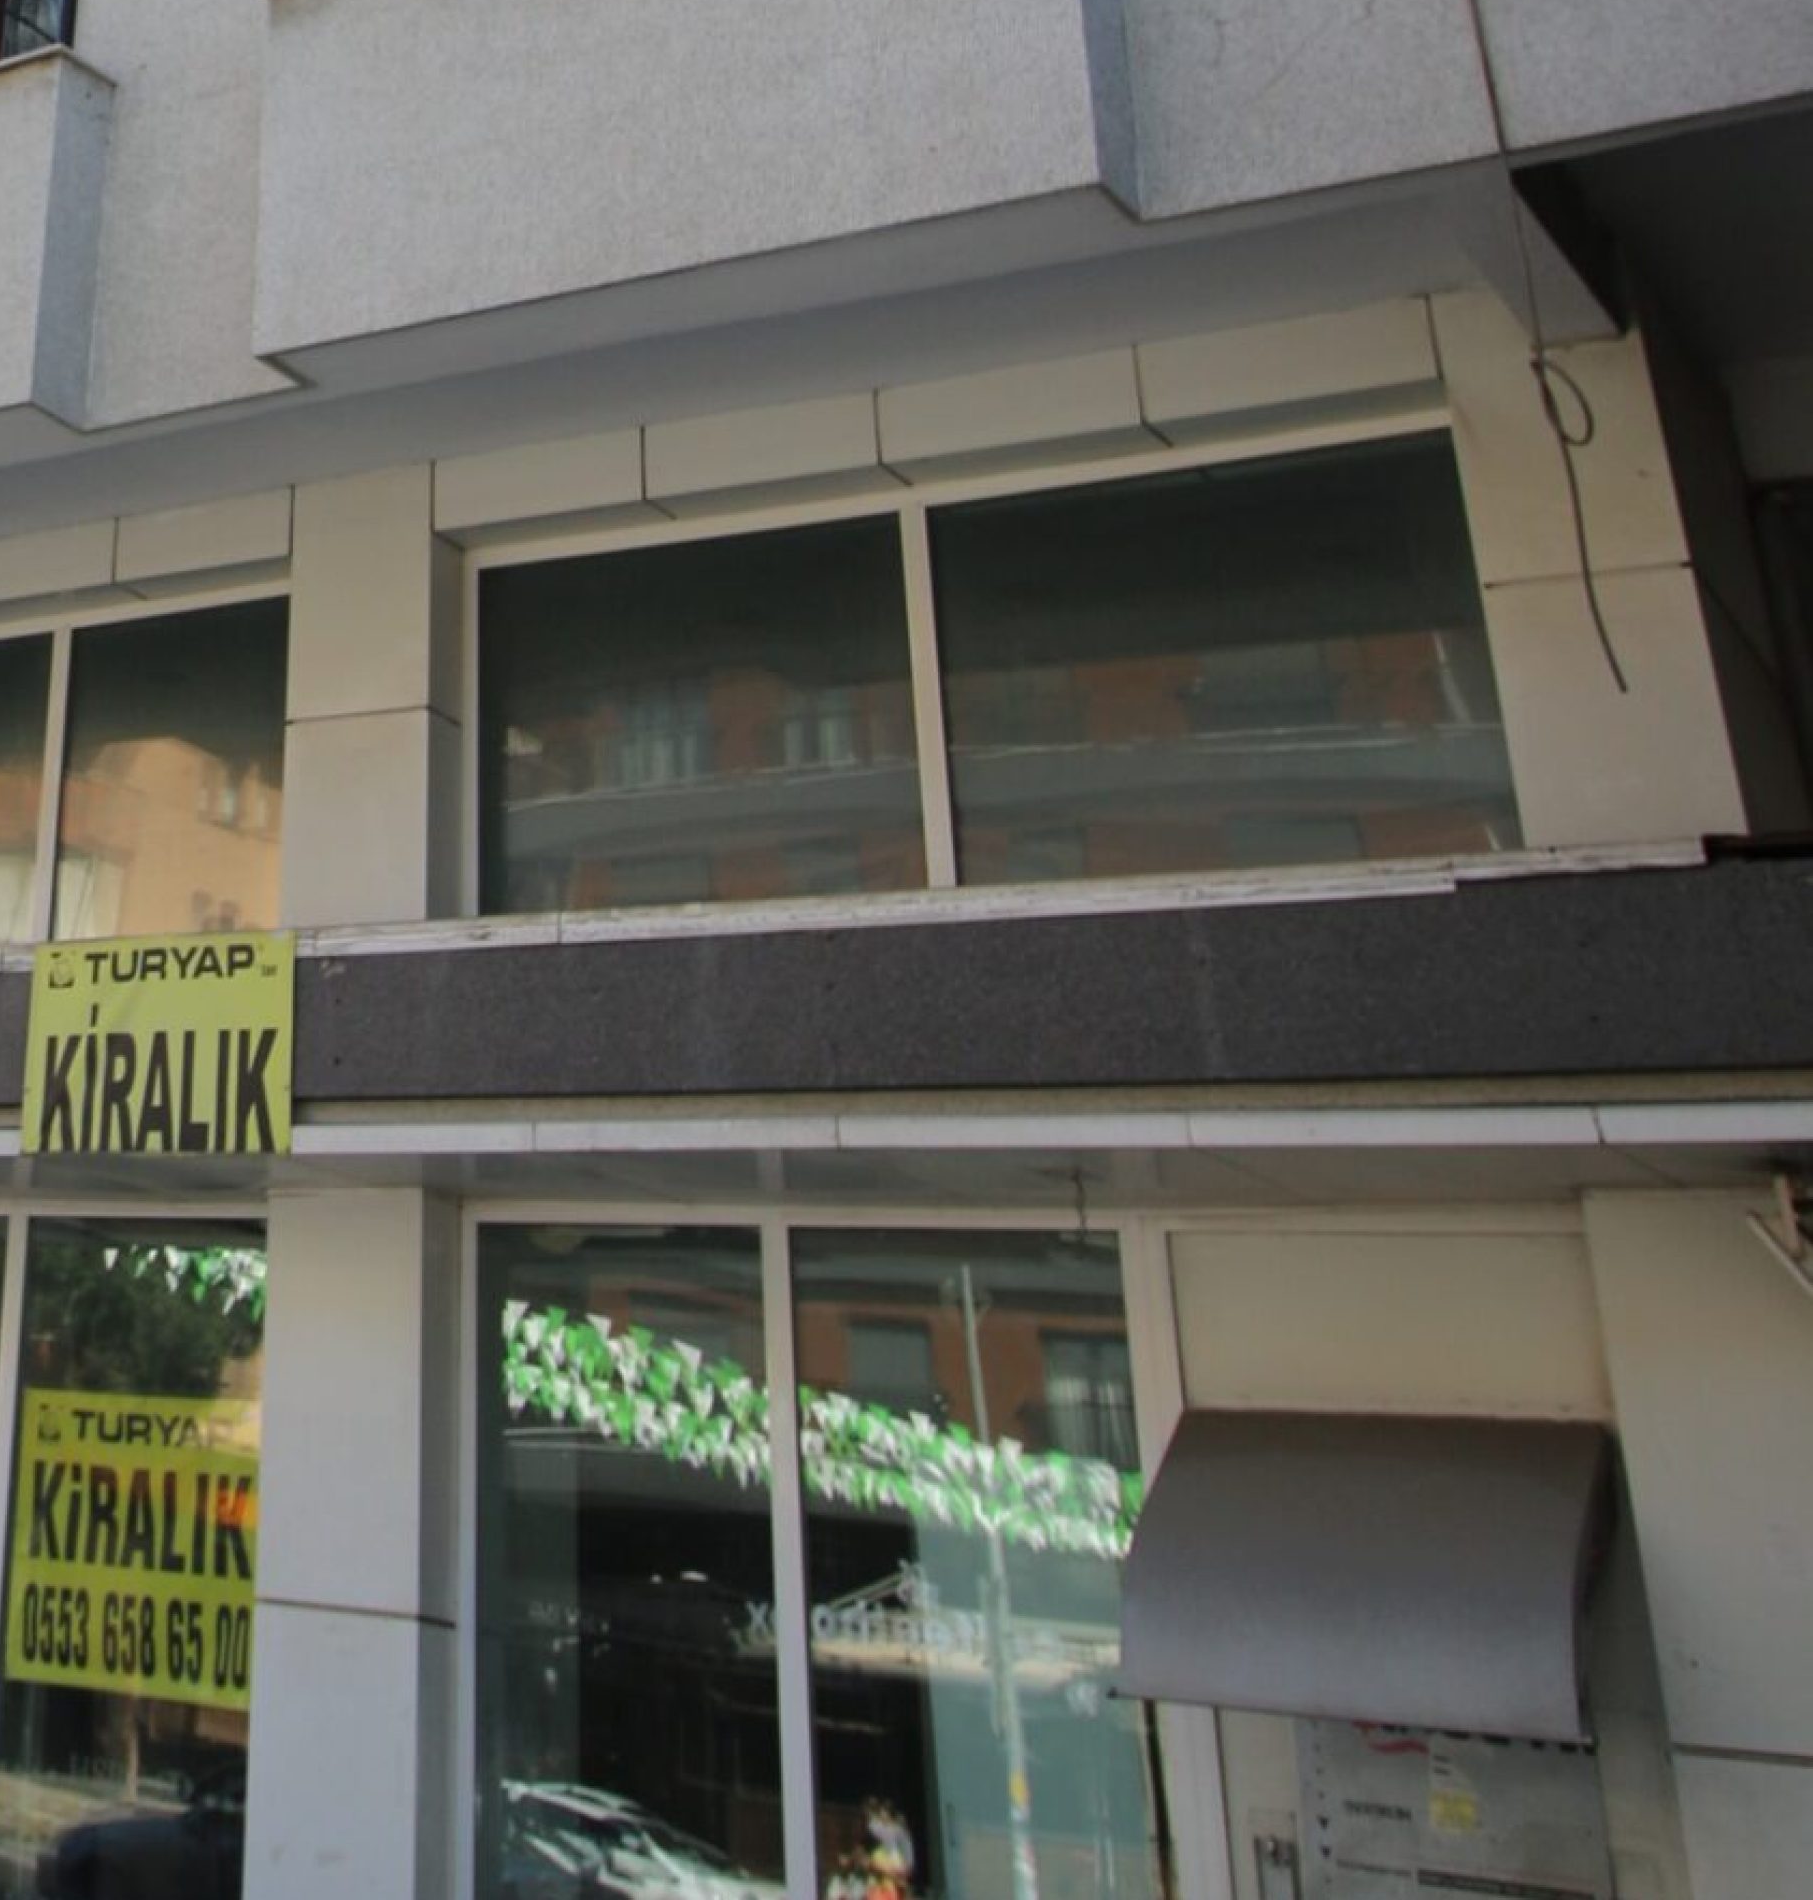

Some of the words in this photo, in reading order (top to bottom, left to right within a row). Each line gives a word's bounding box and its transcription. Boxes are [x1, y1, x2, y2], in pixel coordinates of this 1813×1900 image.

[85, 944, 254, 984] TURYAP
[39, 1003, 278, 1153] KİRALIK
[71, 1410, 234, 1449] TURYAP
[22, 1582, 90, 1668] 0553
[102, 1591, 156, 1677] 658
[167, 1597, 204, 1683] 65
[214, 1604, 250, 1689] 00
